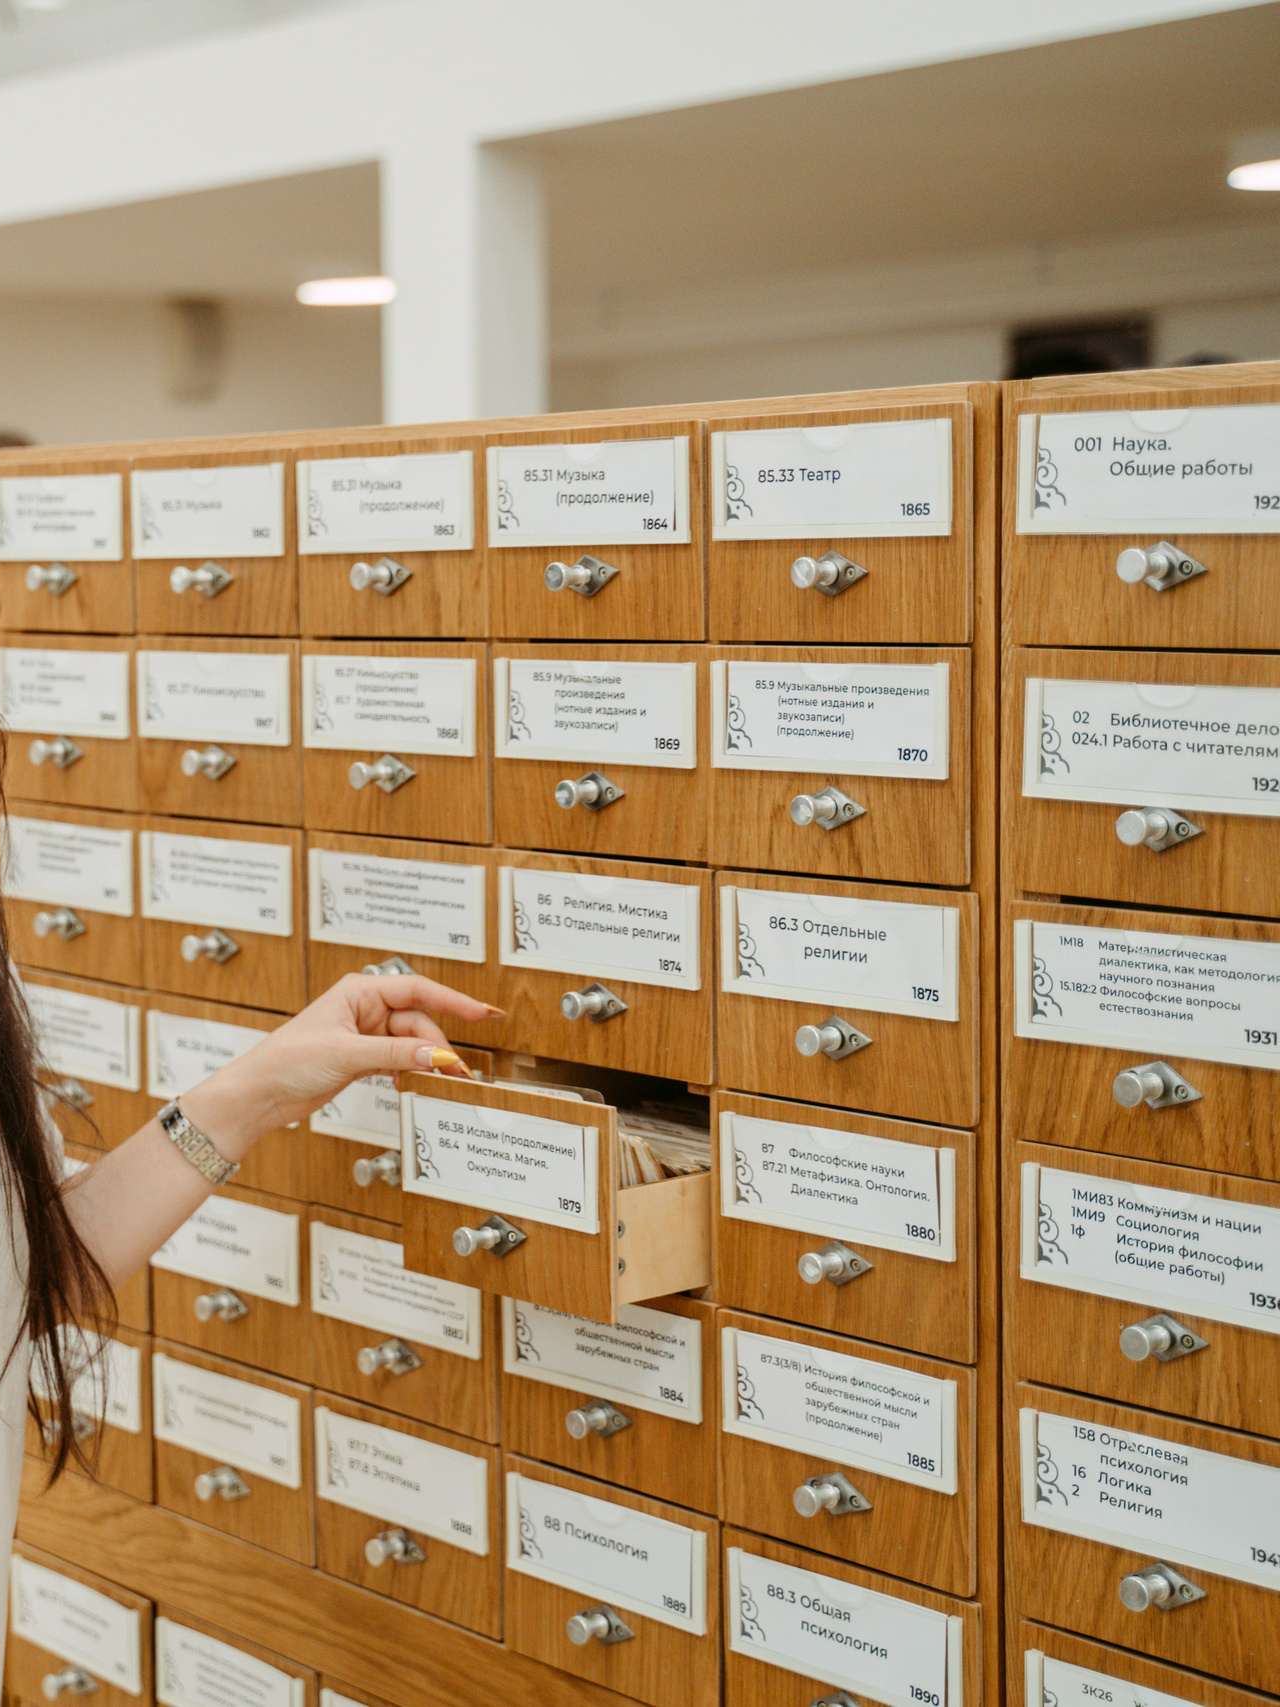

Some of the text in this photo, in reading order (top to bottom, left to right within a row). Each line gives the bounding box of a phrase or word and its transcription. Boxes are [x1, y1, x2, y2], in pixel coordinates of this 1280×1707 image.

[1074, 436, 1172, 455] 001 Наука.
[523, 469, 606, 485] 85.31 Музыка
[757, 467, 841, 484] 85.33 Театр
[1109, 458, 1253, 480] Общие работы
[556, 489, 654, 507] (продолжение)
[900, 502, 931, 517] 1865
[642, 517, 669, 531] 1864
[533, 671, 622, 685] 85.9 Музыкальные
[754, 679, 930, 697] 85.9 Музыкальные произведения
[554, 689, 626, 701] произведения
[777, 695, 875, 710] (нотные издания и
[554, 703, 647, 717] (нотные издания и
[777, 712, 845, 726] звукозаписи)
[554, 719, 619, 733] звукозаписи)
[776, 725, 855, 741] (продолжение)
[1072, 710, 1280, 737] 02 Библиотечное дело
[653, 736, 681, 751] 1869
[1071, 731, 1108, 747] 024.1
[1112, 734, 1168, 752] Работа
[1172, 741, 1182, 752] с
[897, 747, 929, 763] 1870
[1251, 776, 1280, 793] 192
[537, 893, 668, 921] 86 Религия. Мистика
[537, 913, 681, 943] 86.3 Отдельные религии
[768, 915, 887, 942] 86.3 Отдельные
[804, 946, 868, 964] религии
[1098, 940, 1227, 962] Материалистическая
[658, 957, 682, 974] 1874
[1098, 957, 1171, 974] диалектика,
[1174, 965, 1195, 975] как
[1099, 972, 1215, 993] научного познания
[911, 985, 940, 1003] 1875
[1099, 985, 1183, 1005] Философские
[1185, 997, 1241, 1011] вопросы
[1099, 1003, 1194, 1022] естествознания
[1244, 1028, 1278, 1046] 1931
[437, 1119, 576, 1161] 86.38 Ислам (продолжение)
[438, 1137, 549, 1170] 86.4 Мистика. Магия.
[761, 1142, 905, 1179] 87 Философские науки
[466, 1160, 526, 1182] Оккультизм
[762, 1160, 930, 1202] 87.21 Метафизика. Онтология.
[558, 1196, 582, 1214] 1879
[790, 1183, 859, 1206] Диалектика
[1117, 1197, 1198, 1223] Коммунизм
[1202, 1215, 1211, 1225] и
[1215, 1217, 1262, 1235] нации
[905, 1223, 936, 1241] 1880
[1115, 1214, 1200, 1242] Социология
[1116, 1232, 1175, 1255] История
[1178, 1245, 1264, 1272] философии
[1114, 1249, 1225, 1286] (общие работы)
[574, 1326, 675, 1361] общественной мысли
[679, 1339, 686, 1347] и
[575, 1343, 660, 1372] зарубежных стран
[659, 1385, 684, 1403] 1884
[804, 1364, 848, 1384] История
[849, 1376, 921, 1404] философской
[923, 1397, 930, 1407] и
[804, 1381, 918, 1419] общественной мысли
[805, 1397, 900, 1431] зарубежных стран
[805, 1412, 883, 1443] (продолжение)
[1073, 1425, 1188, 1467] 158 Отраслевая
[906, 1452, 935, 1472] 1885
[1100, 1454, 1188, 1486] психология
[1072, 1464, 1152, 1497] 16 Логика
[1071, 1483, 1163, 1519] 2 Религия
[543, 1515, 648, 1562] 88 Психология
[662, 1594, 687, 1614] 1889
[766, 1583, 851, 1623] 88.3 Общая
[800, 1620, 888, 1660] психология
[909, 1685, 940, 1707] 1890
